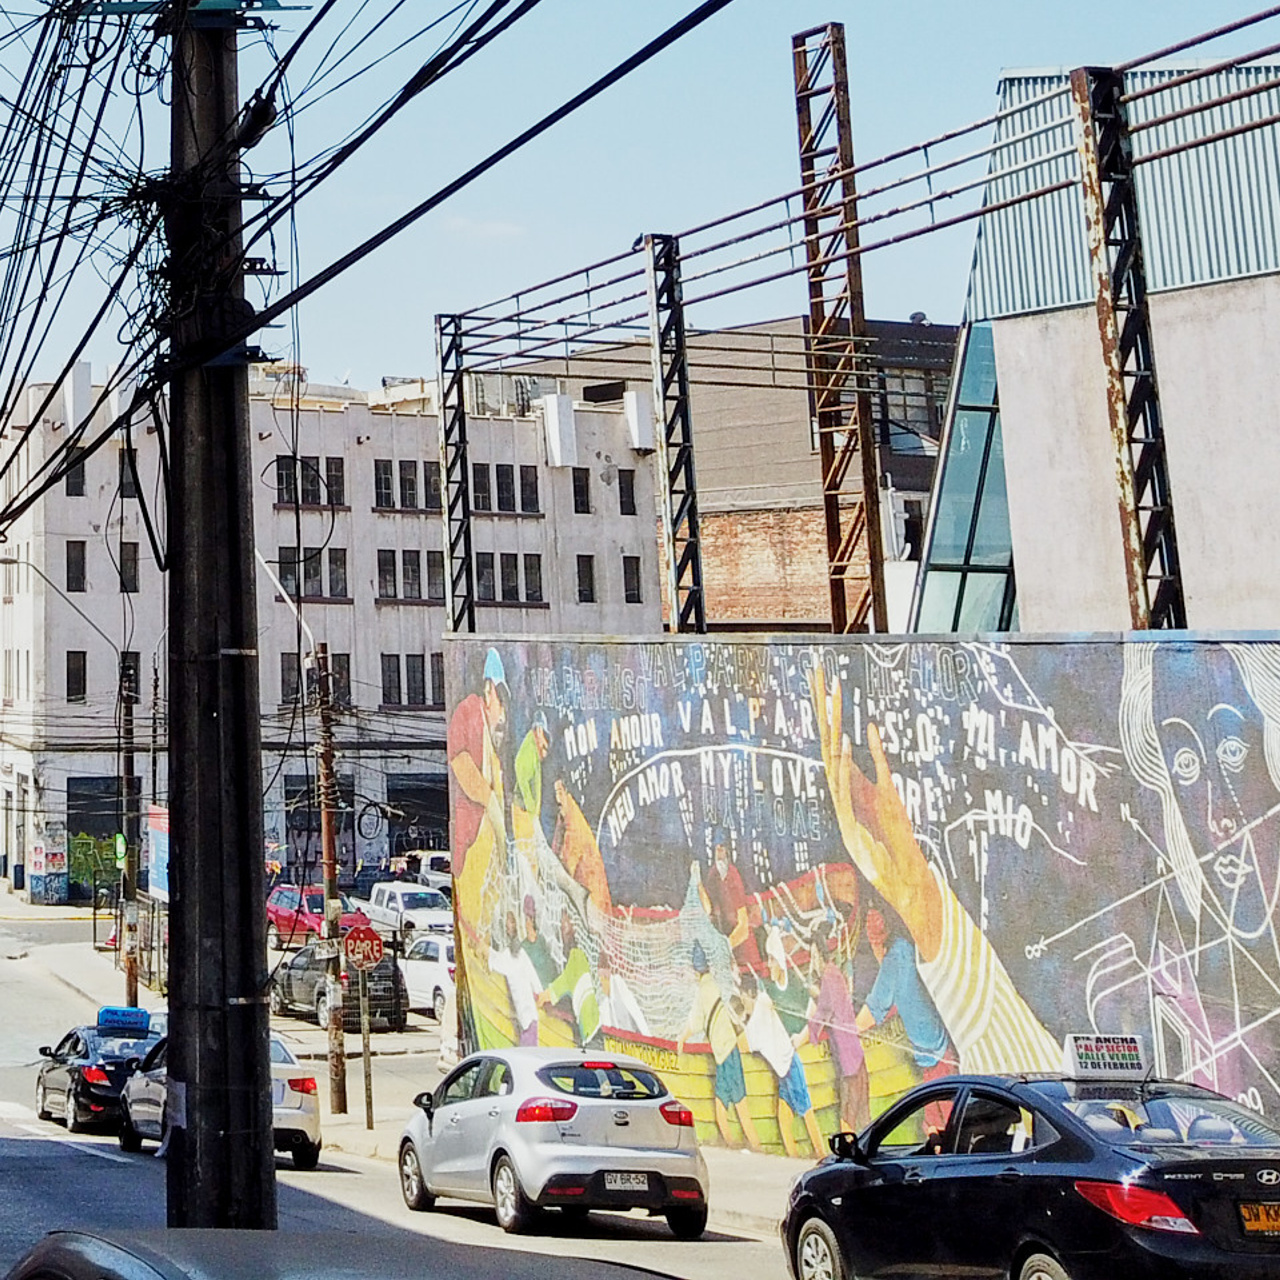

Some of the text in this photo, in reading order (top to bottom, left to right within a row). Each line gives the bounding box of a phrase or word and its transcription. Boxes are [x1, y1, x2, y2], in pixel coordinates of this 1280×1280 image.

[564, 712, 664, 760] MON AMOUR
[700, 750, 732, 789] MY
[1019, 720, 1098, 812] AMOR
[607, 761, 686, 848] MEU AMOR
[984, 789, 1033, 850] MIO
[347, 939, 380, 960] PARE
[1084, 1044, 1094, 1052] AL
[1105, 1044, 1139, 1052] SECTOR
[1095, 1036, 1137, 1044] ANCHA
[1103, 1062, 1143, 1070] FEBRERO
[1108, 1053, 1141, 1061] VERDE
